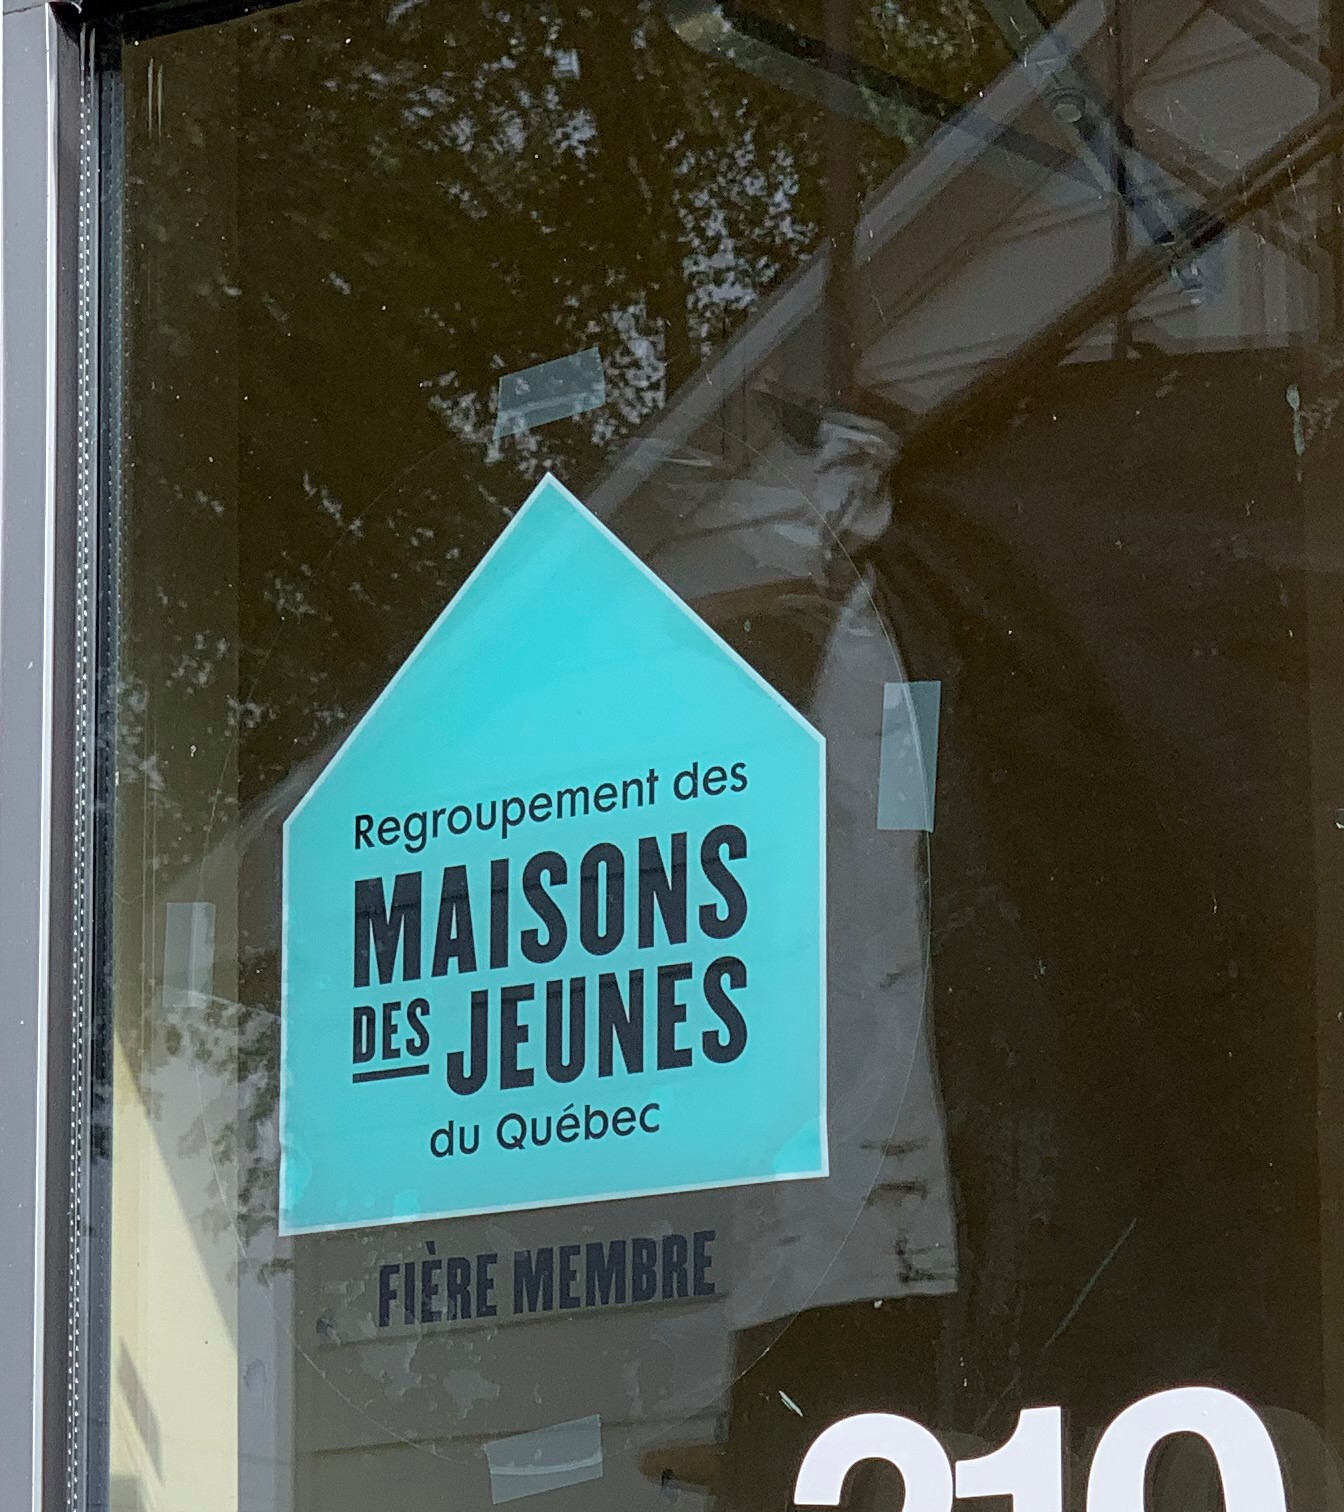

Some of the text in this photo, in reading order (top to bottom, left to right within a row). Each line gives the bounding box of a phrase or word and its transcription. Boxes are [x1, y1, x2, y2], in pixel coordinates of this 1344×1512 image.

[353, 760, 749, 854] Regroupement des
[353, 823, 749, 988] MAISONS
[352, 955, 749, 1096] DES JEUNES
[430, 1102, 662, 1158] du Québec
[378, 1230, 717, 1328] FIÈRE MEMBRE
